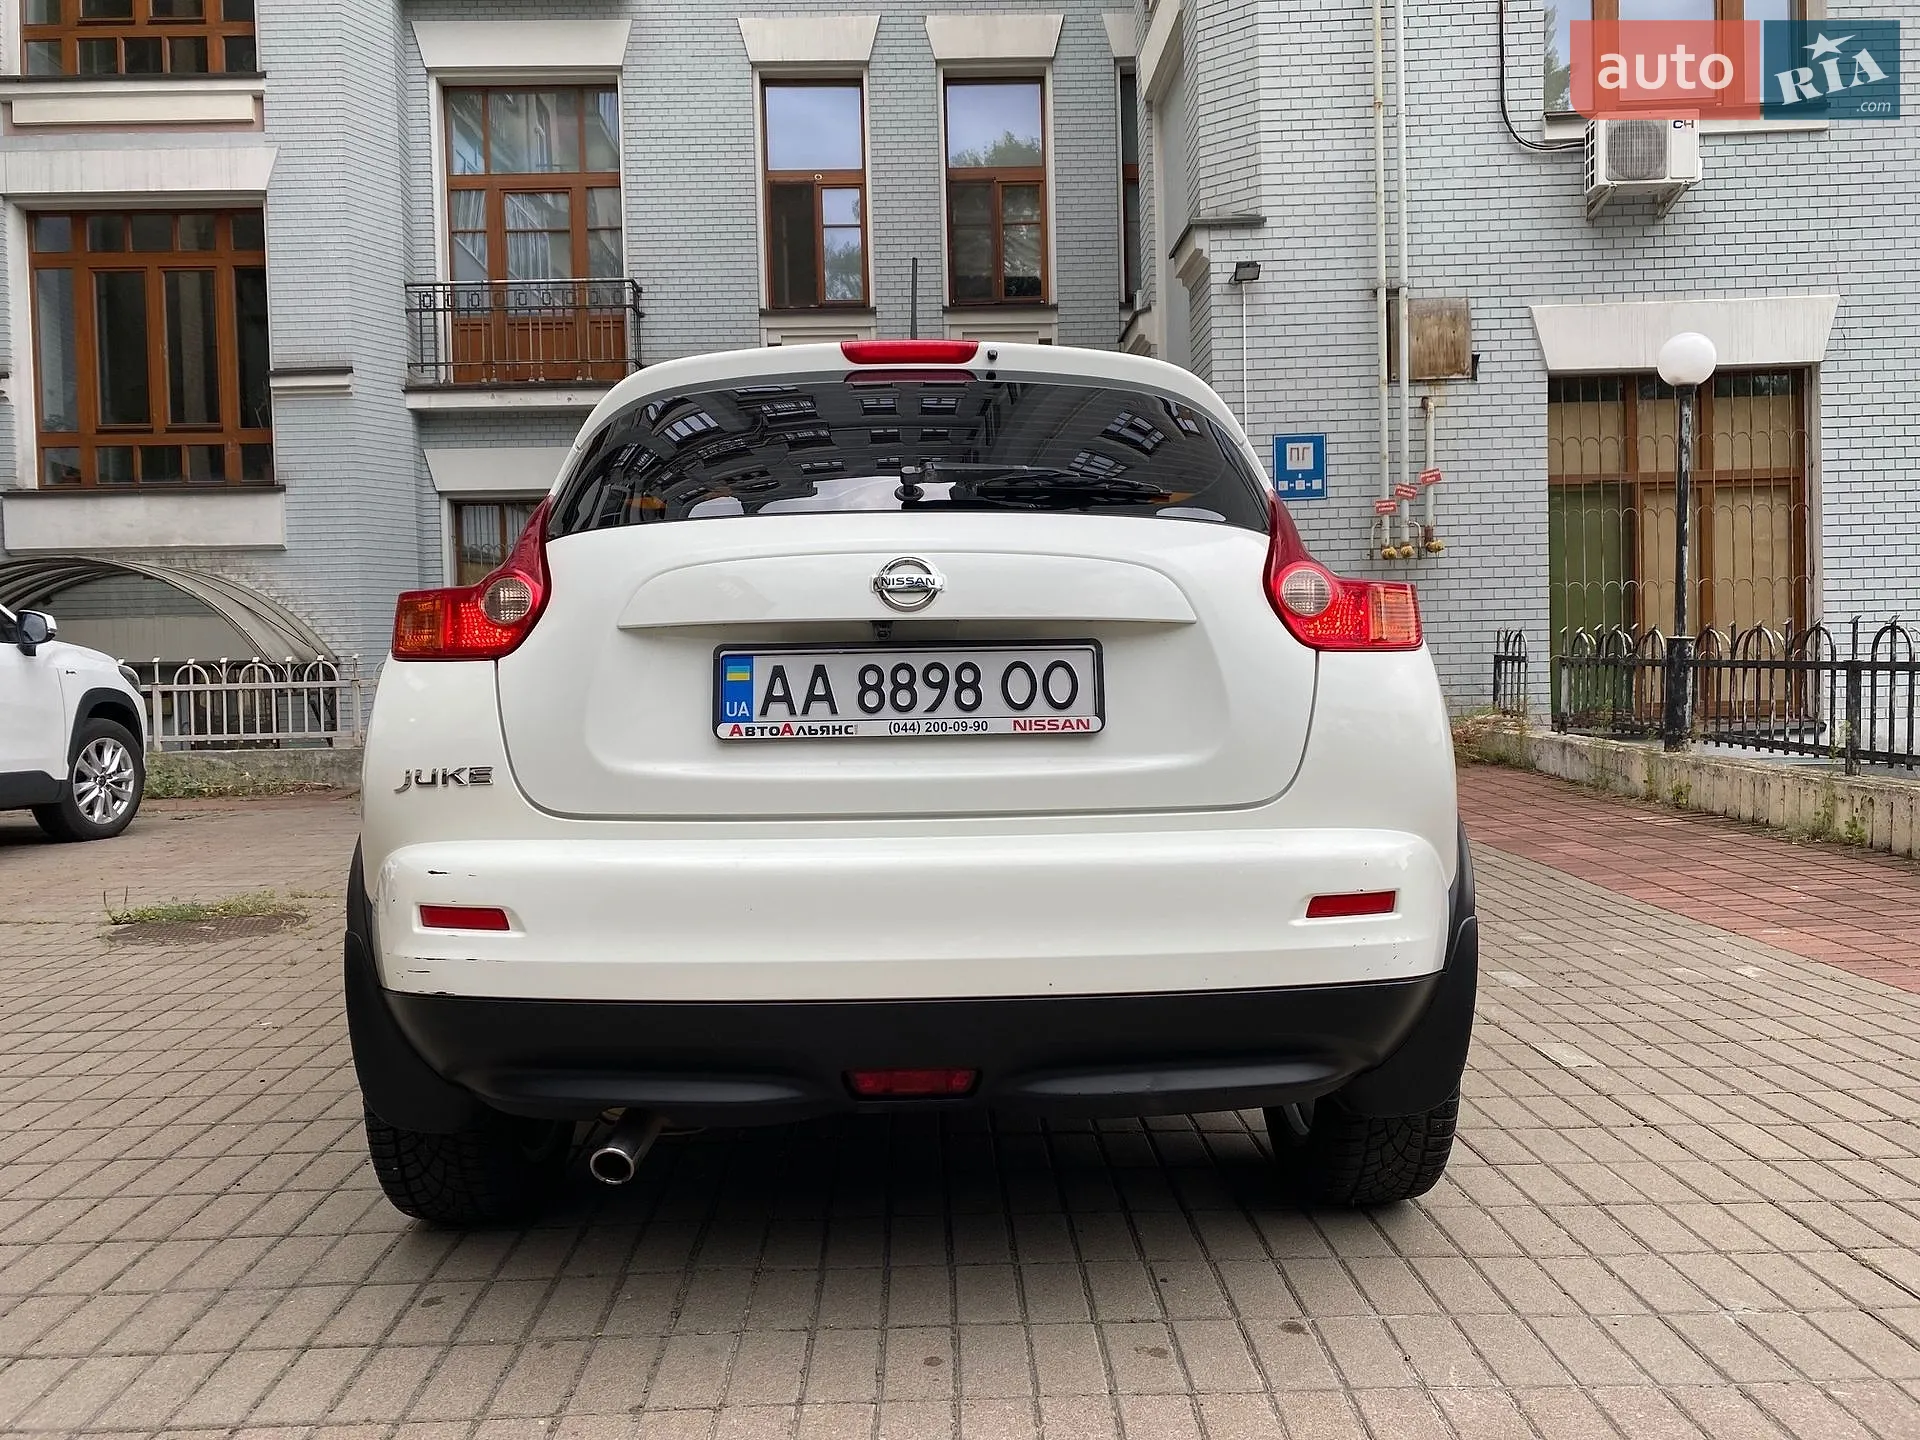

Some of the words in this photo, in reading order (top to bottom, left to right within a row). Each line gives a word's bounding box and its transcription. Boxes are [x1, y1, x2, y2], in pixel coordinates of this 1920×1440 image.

[881, 576, 936, 586] NISSAN
[759, 664, 839, 717] AA
[857, 661, 983, 715] 8898
[726, 702, 750, 717] UA
[888, 721, 921, 736] (044)
[925, 720, 988, 734] 200-09-90
[1012, 718, 1091, 732] NISSAN
